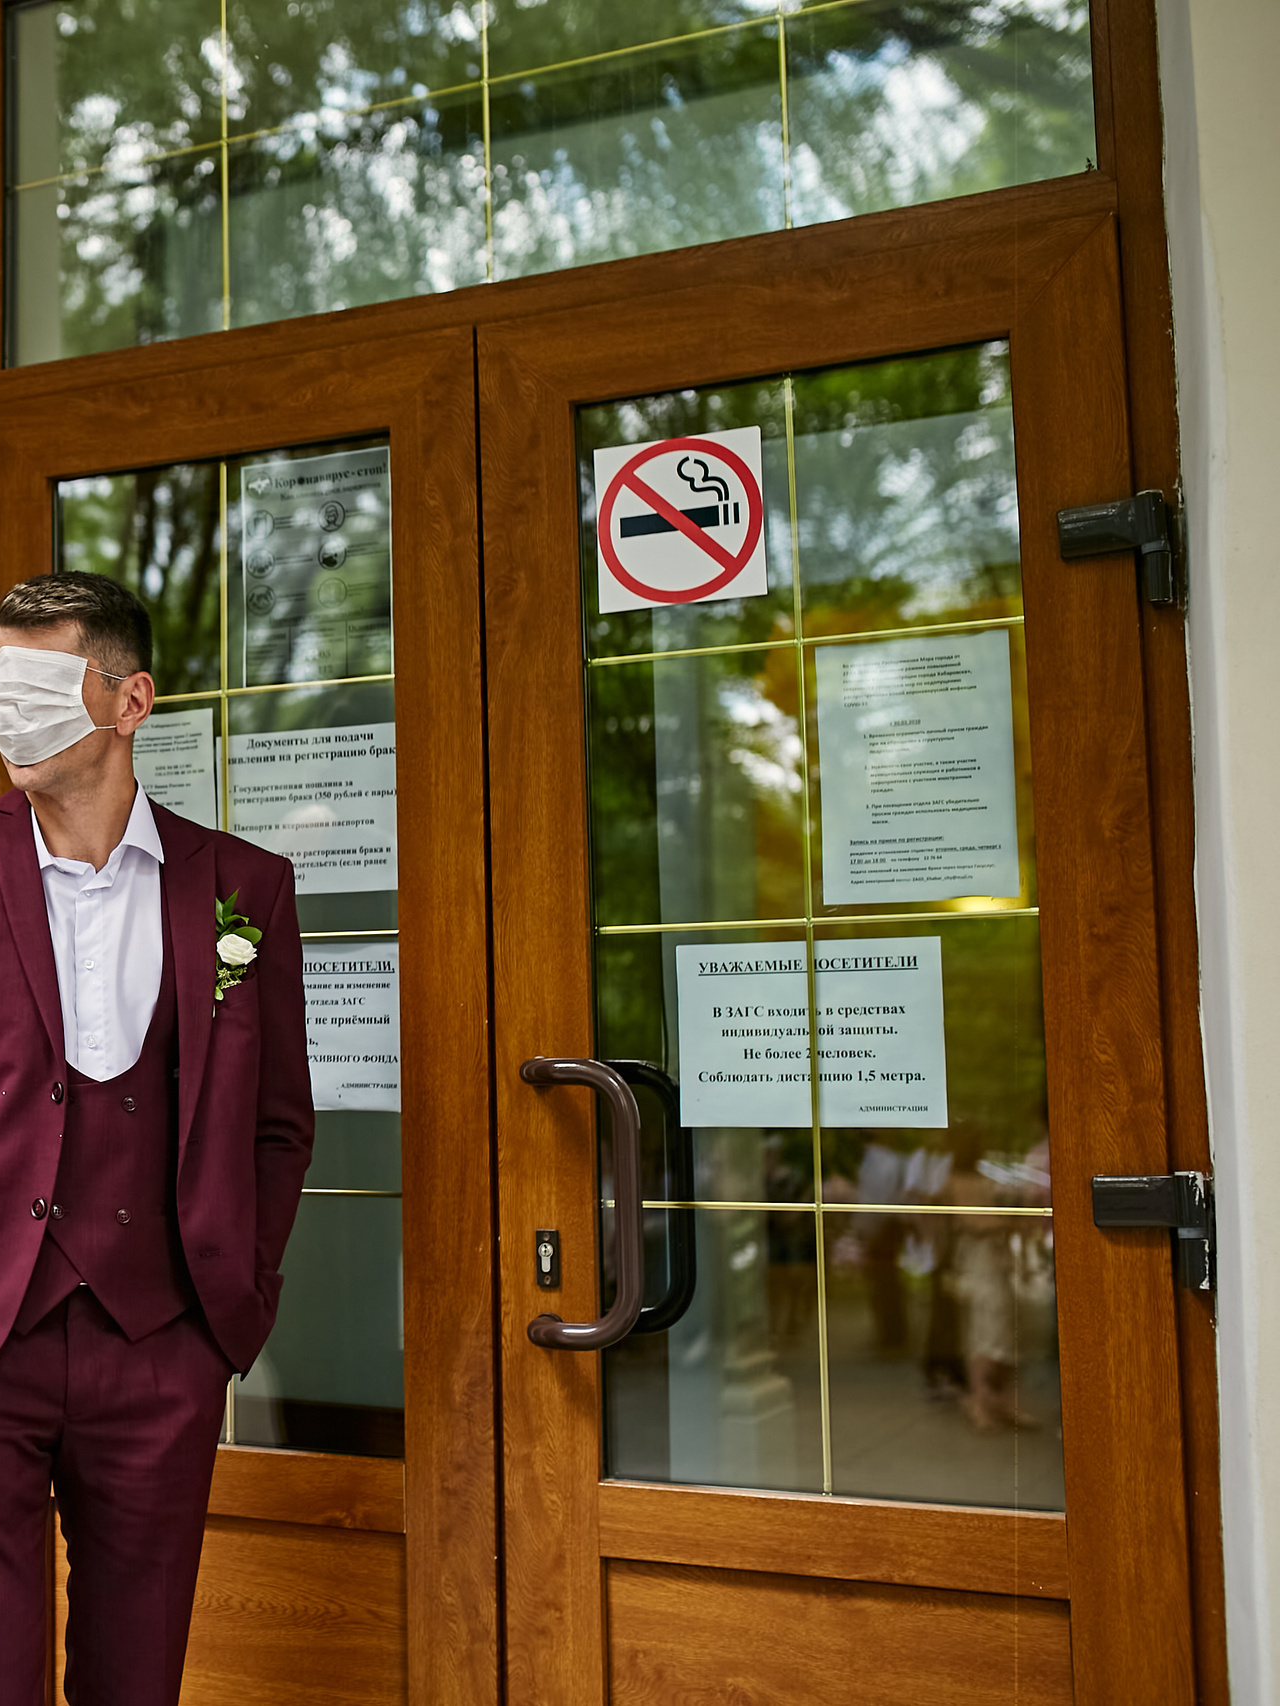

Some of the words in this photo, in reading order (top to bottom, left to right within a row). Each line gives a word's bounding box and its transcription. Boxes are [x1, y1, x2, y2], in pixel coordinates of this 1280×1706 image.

[246, 738, 309, 750] Документы
[311, 735, 331, 745] для
[334, 732, 374, 743] подачи
[221, 754, 275, 766] явления
[279, 754, 291, 762] на
[294, 748, 366, 763] регистрацию
[233, 783, 303, 795] Государственная
[305, 781, 342, 790] пошлина
[233, 795, 286, 806] регистрацию
[288, 793, 312, 804] брака
[333, 789, 363, 800] рублей
[331, 818, 375, 828] паспортов
[303, 848, 357, 859] расторжении
[359, 846, 383, 856] брака
[339, 858, 362, 868] (если
[364, 858, 387, 868] ранее
[304, 961, 395, 974] ПОСЕТИТЕЛИ,
[698, 959, 803, 974] УВАЖАЕМЫЕ
[341, 997, 366, 1006] ЗАГС
[712, 1007, 722, 1018] В
[725, 1006, 764, 1018] ЗАГС
[767, 1007, 821, 1018] входиь
[825, 1007, 833, 1016] в
[837, 1005, 906, 1018] средствах
[315, 1016, 328, 1025] не
[330, 1014, 390, 1027] приёмный
[721, 1024, 834, 1040] индивидуальой
[838, 1025, 898, 1038] защиты.
[362, 1054, 398, 1064] ФОНДА
[743, 1048, 762, 1060] Не
[765, 1047, 802, 1060] более
[817, 1048, 877, 1060] человек.
[698, 1070, 773, 1083] Соблюдать
[857, 1070, 876, 1083] 1,5
[880, 1071, 926, 1084] метра.
[858, 1105, 928, 1113] АДМИНИСТРАЦИЯ
